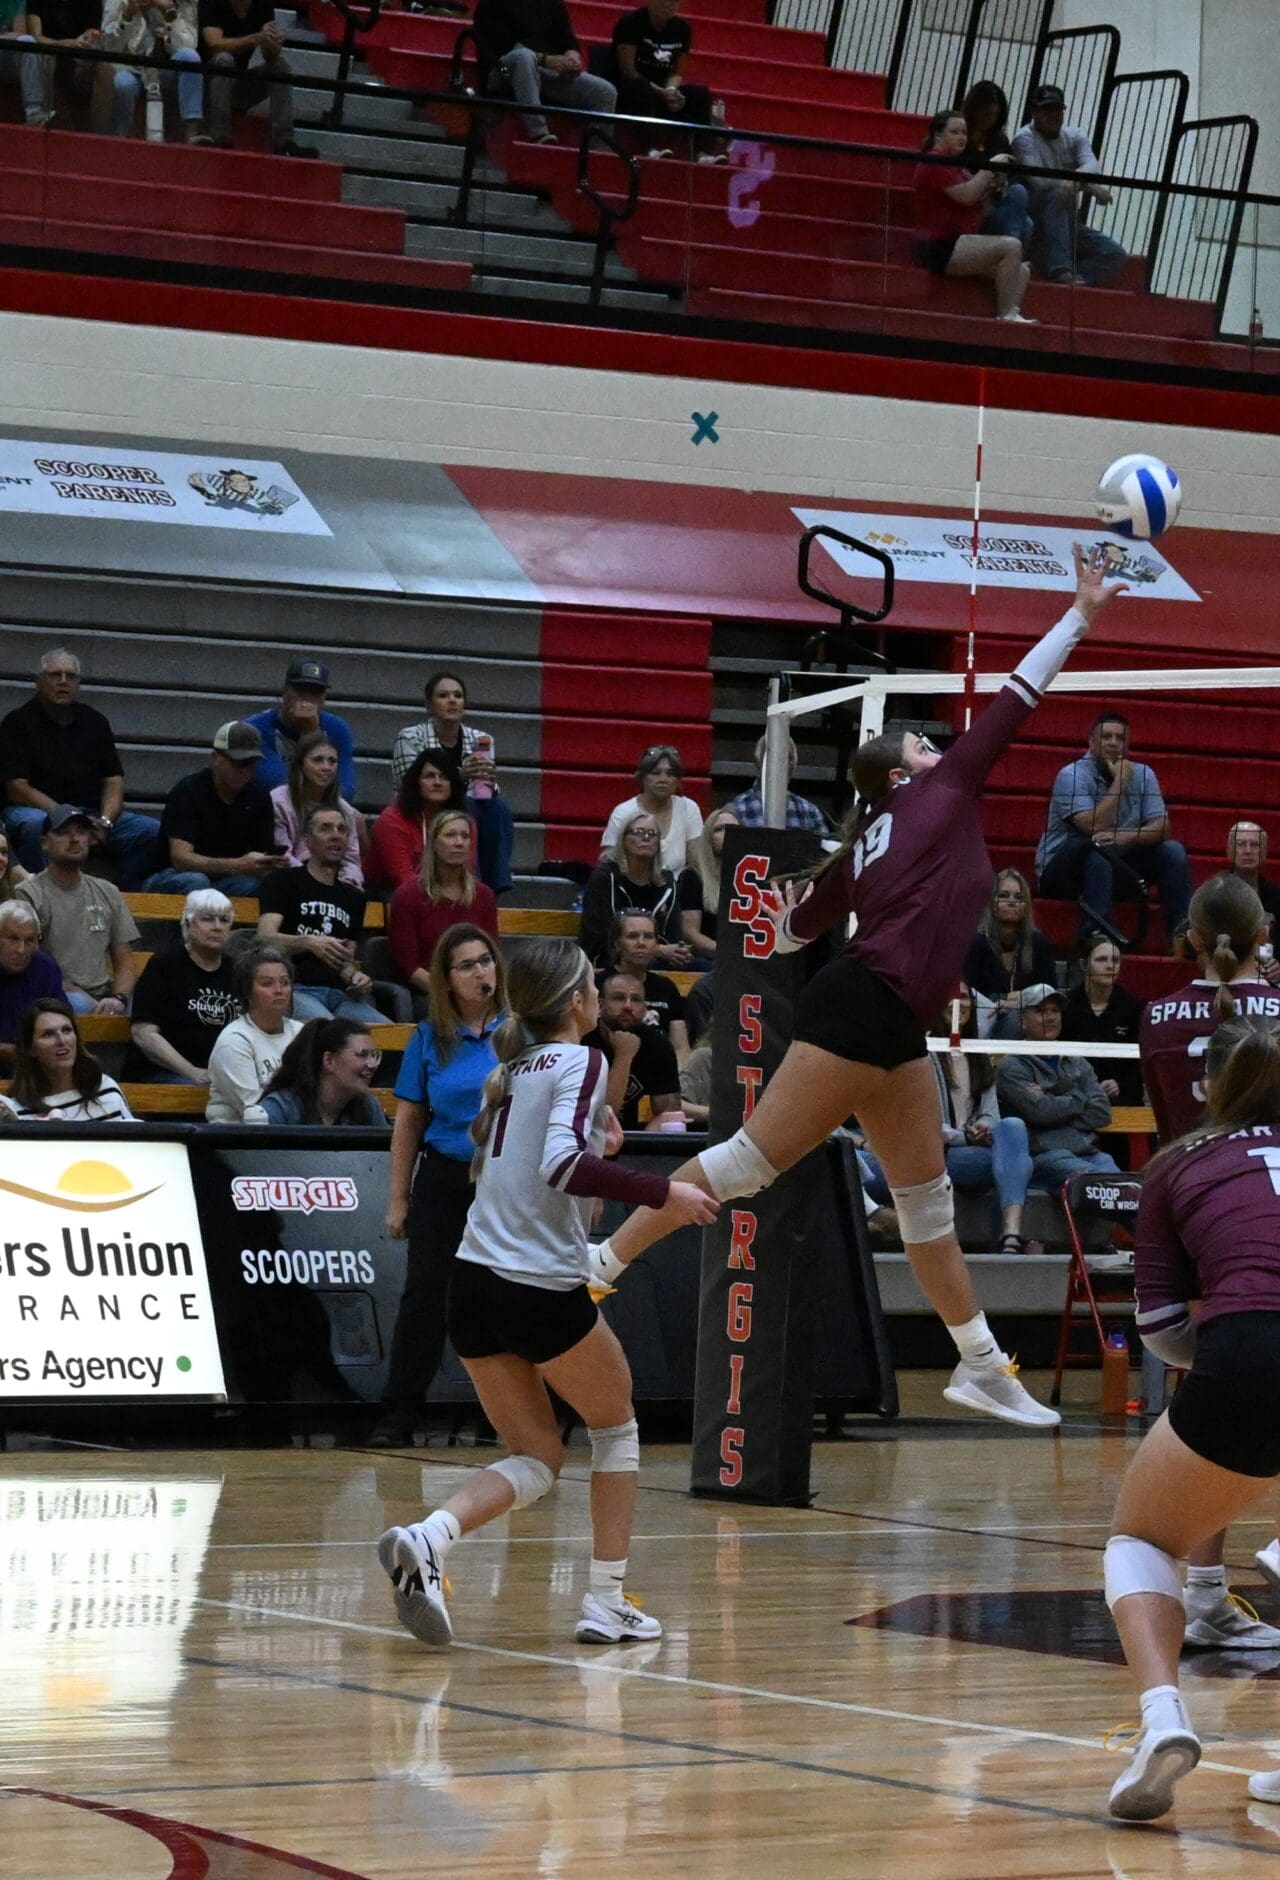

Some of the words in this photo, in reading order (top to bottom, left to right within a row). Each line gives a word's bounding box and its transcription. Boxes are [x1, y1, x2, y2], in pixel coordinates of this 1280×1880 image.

[34, 459, 165, 485] SCOOPER
[52, 481, 176, 507] PARENTS
[853, 812, 893, 881] 19
[300, 901, 351, 929] STURGIS
[1150, 996, 1280, 1025] SPARANS
[232, 1177, 358, 1215] STURGIS
[1085, 1186, 1121, 1200] SCOOP
[62, 1227, 193, 1277] Union
[240, 1249, 375, 1284] SCOOPERS
[42, 1350, 164, 1388] Agency
